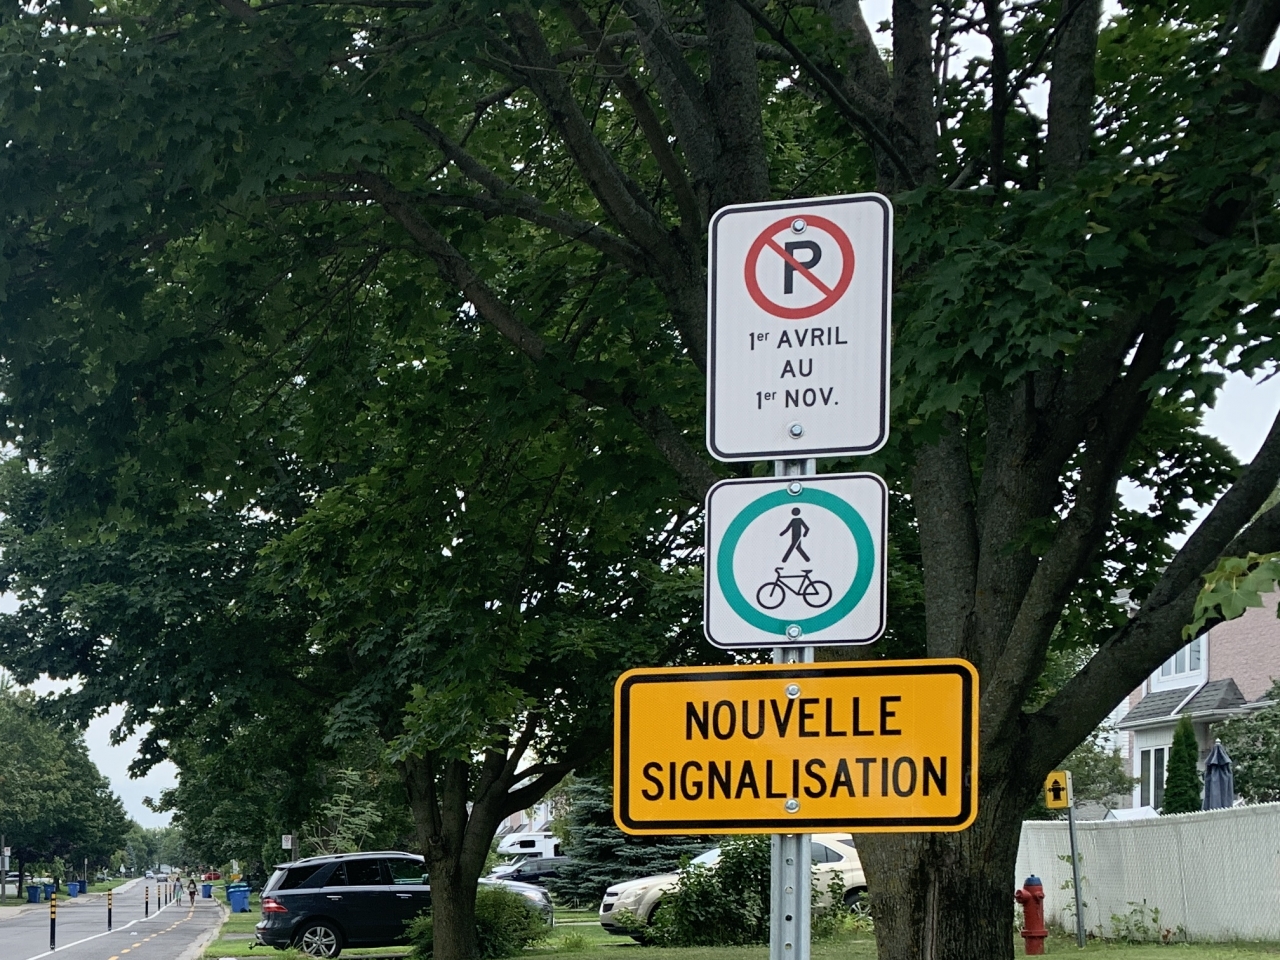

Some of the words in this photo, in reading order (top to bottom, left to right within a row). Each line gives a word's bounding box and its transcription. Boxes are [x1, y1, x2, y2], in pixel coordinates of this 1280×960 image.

[783, 240, 822, 295] P
[749, 331, 770, 351] 1er
[776, 326, 848, 349] AVRIL
[780, 358, 813, 379] AU
[756, 390, 777, 410] 1er
[785, 387, 839, 408] NOV.
[685, 695, 902, 741] NOUVELLE
[641, 756, 947, 801] SIGNALISATION
